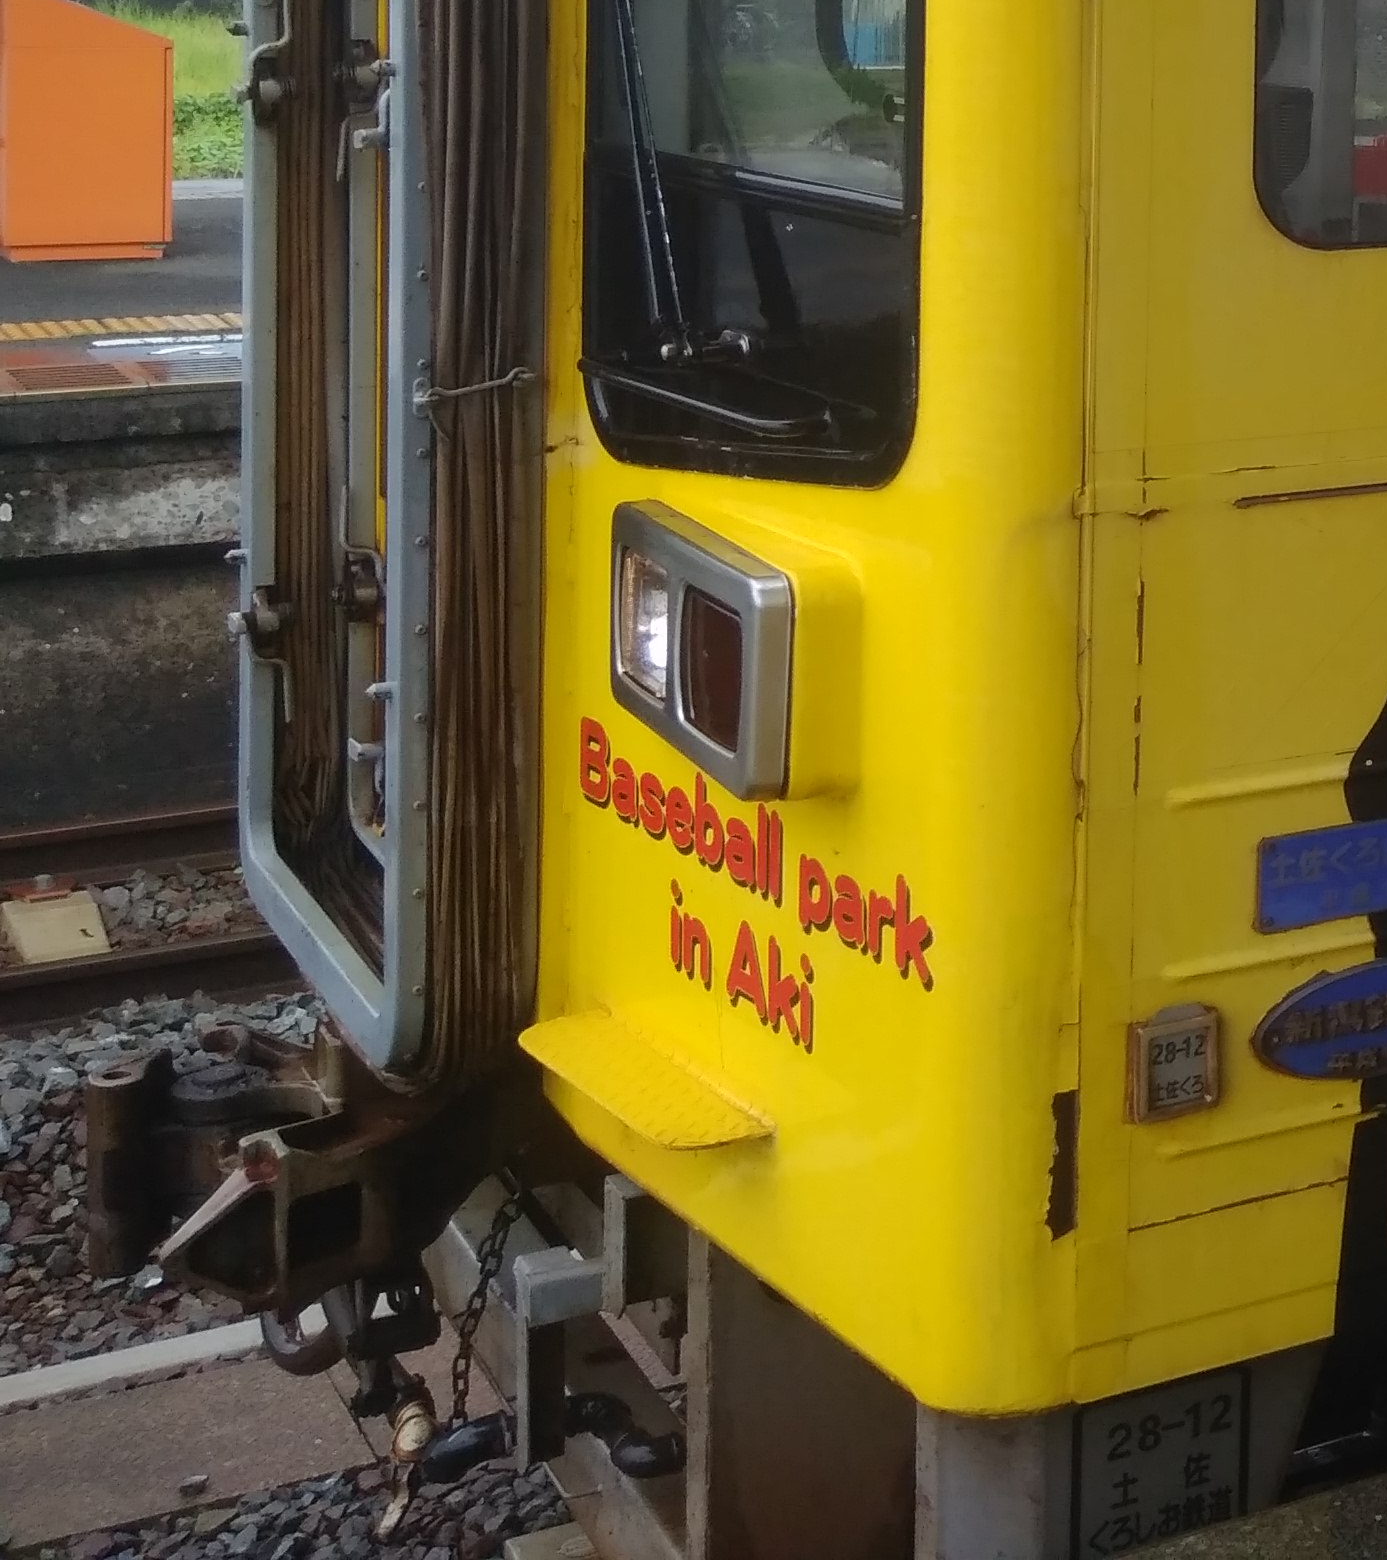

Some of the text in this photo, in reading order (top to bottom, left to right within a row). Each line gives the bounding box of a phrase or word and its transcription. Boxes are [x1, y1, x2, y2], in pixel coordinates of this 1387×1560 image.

[579, 716, 936, 992] Baseball park
[669, 878, 816, 1055] in Aki
[1151, 1034, 1208, 1067] 28-12
[1106, 1393, 1233, 1462] 28-12
[1088, 1484, 1234, 1556] くろしお鉄道
